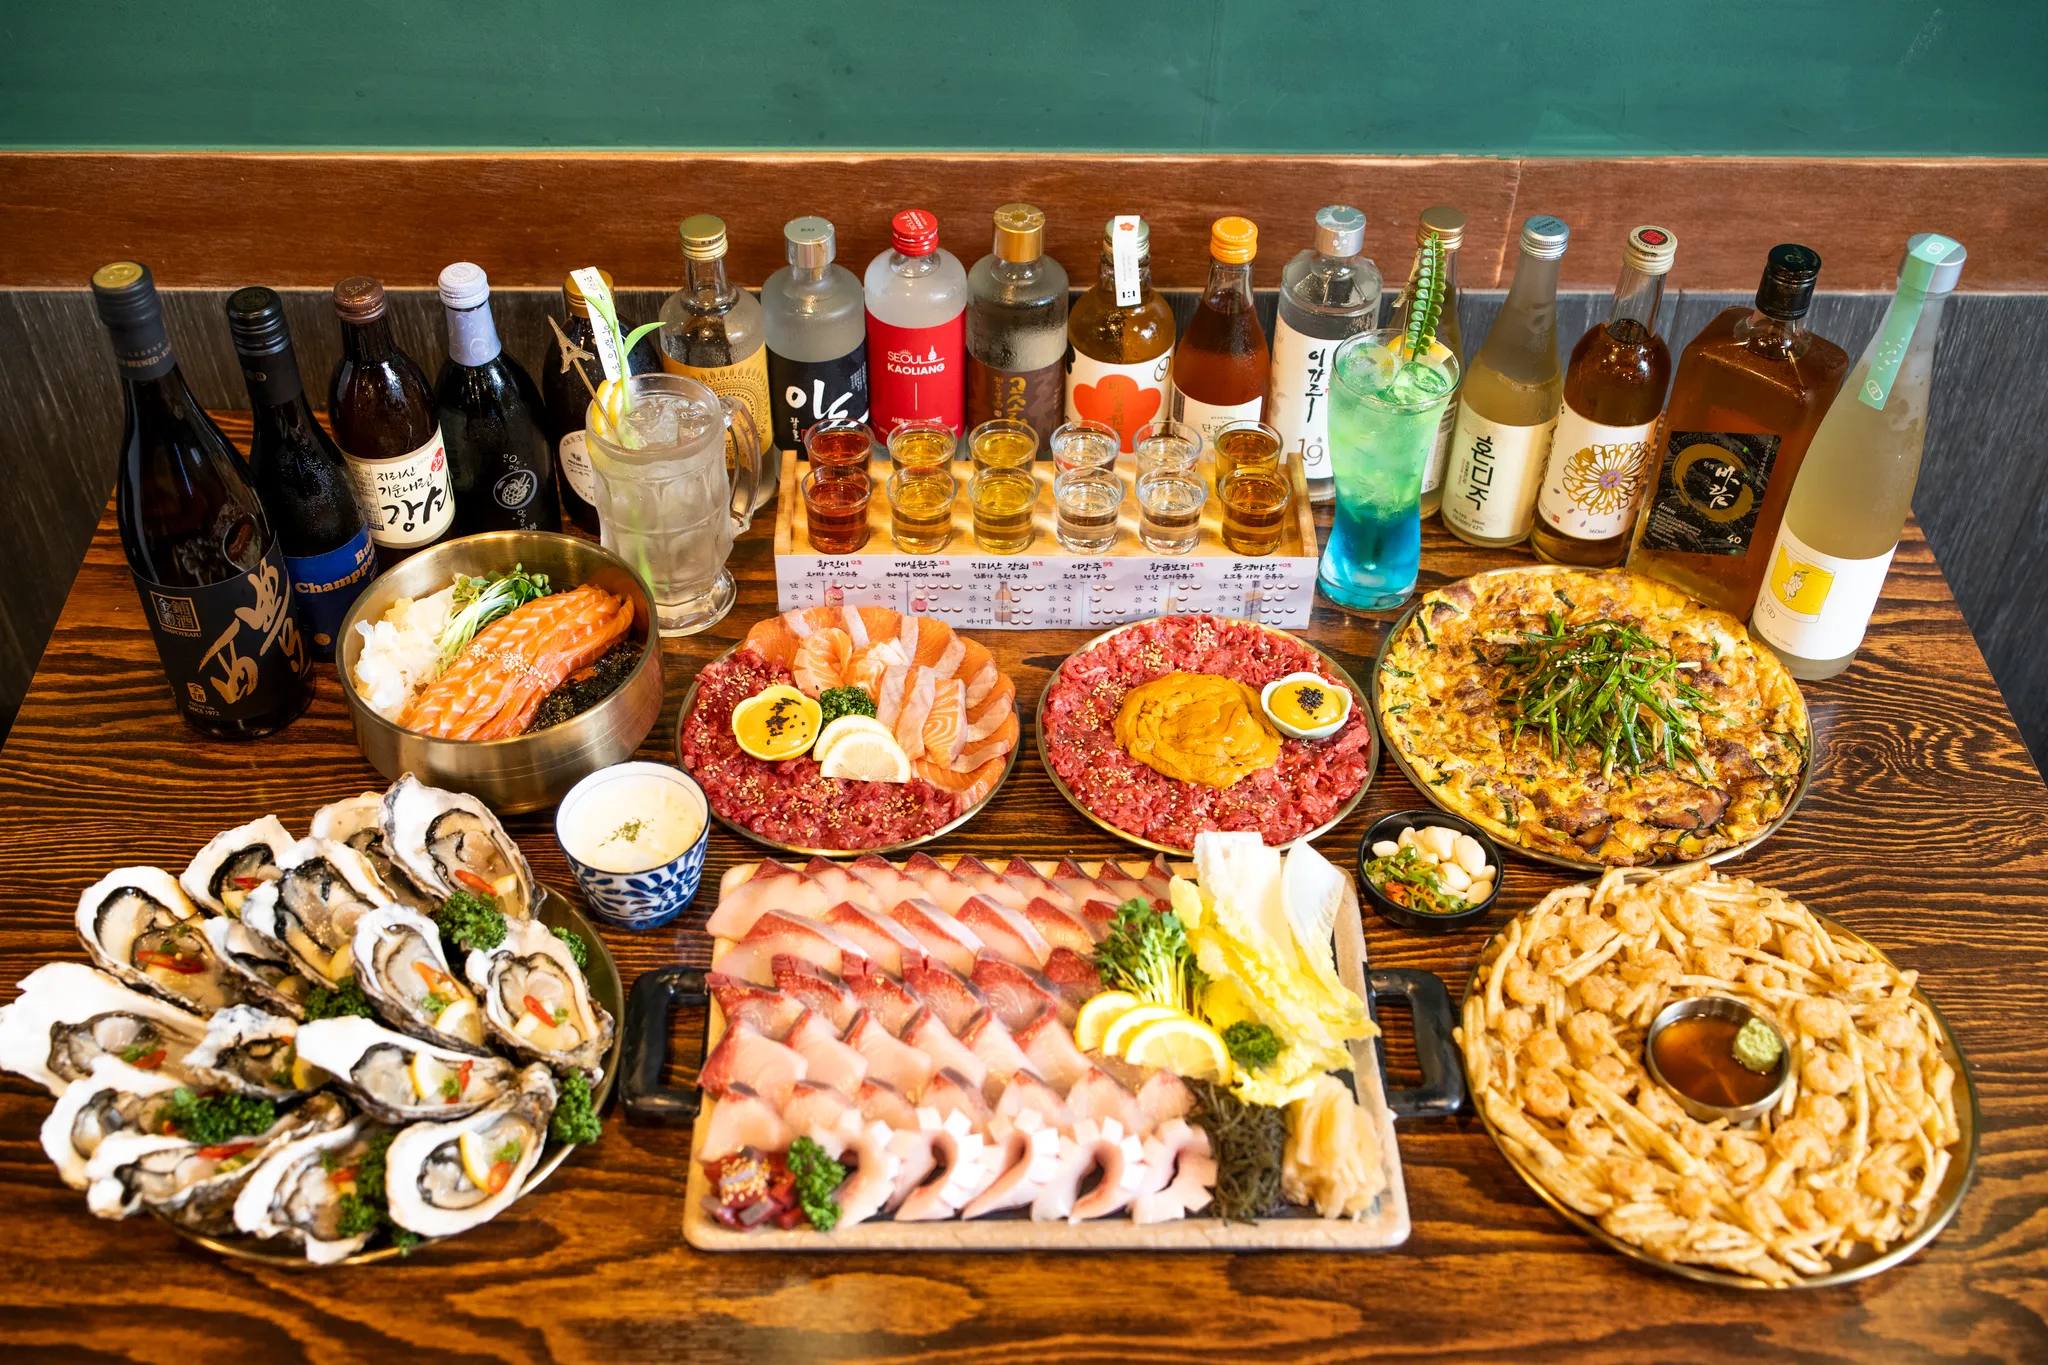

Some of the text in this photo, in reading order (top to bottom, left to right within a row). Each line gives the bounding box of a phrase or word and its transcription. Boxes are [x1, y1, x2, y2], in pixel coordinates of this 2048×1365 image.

[887, 350, 922, 365] SEOUL
[887, 362, 945, 376] KAOLIANG
[1727, 534, 1742, 545] 40
[816, 559, 850, 570] 황진이
[894, 559, 938, 570] 매실원주
[970, 561, 1002, 571] 지리산
[1071, 561, 1103, 572] 이강주
[1149, 562, 1190, 572] 황금보리
[1232, 562, 1278, 572] 문경바람
[912, 571, 930, 579] 100%
